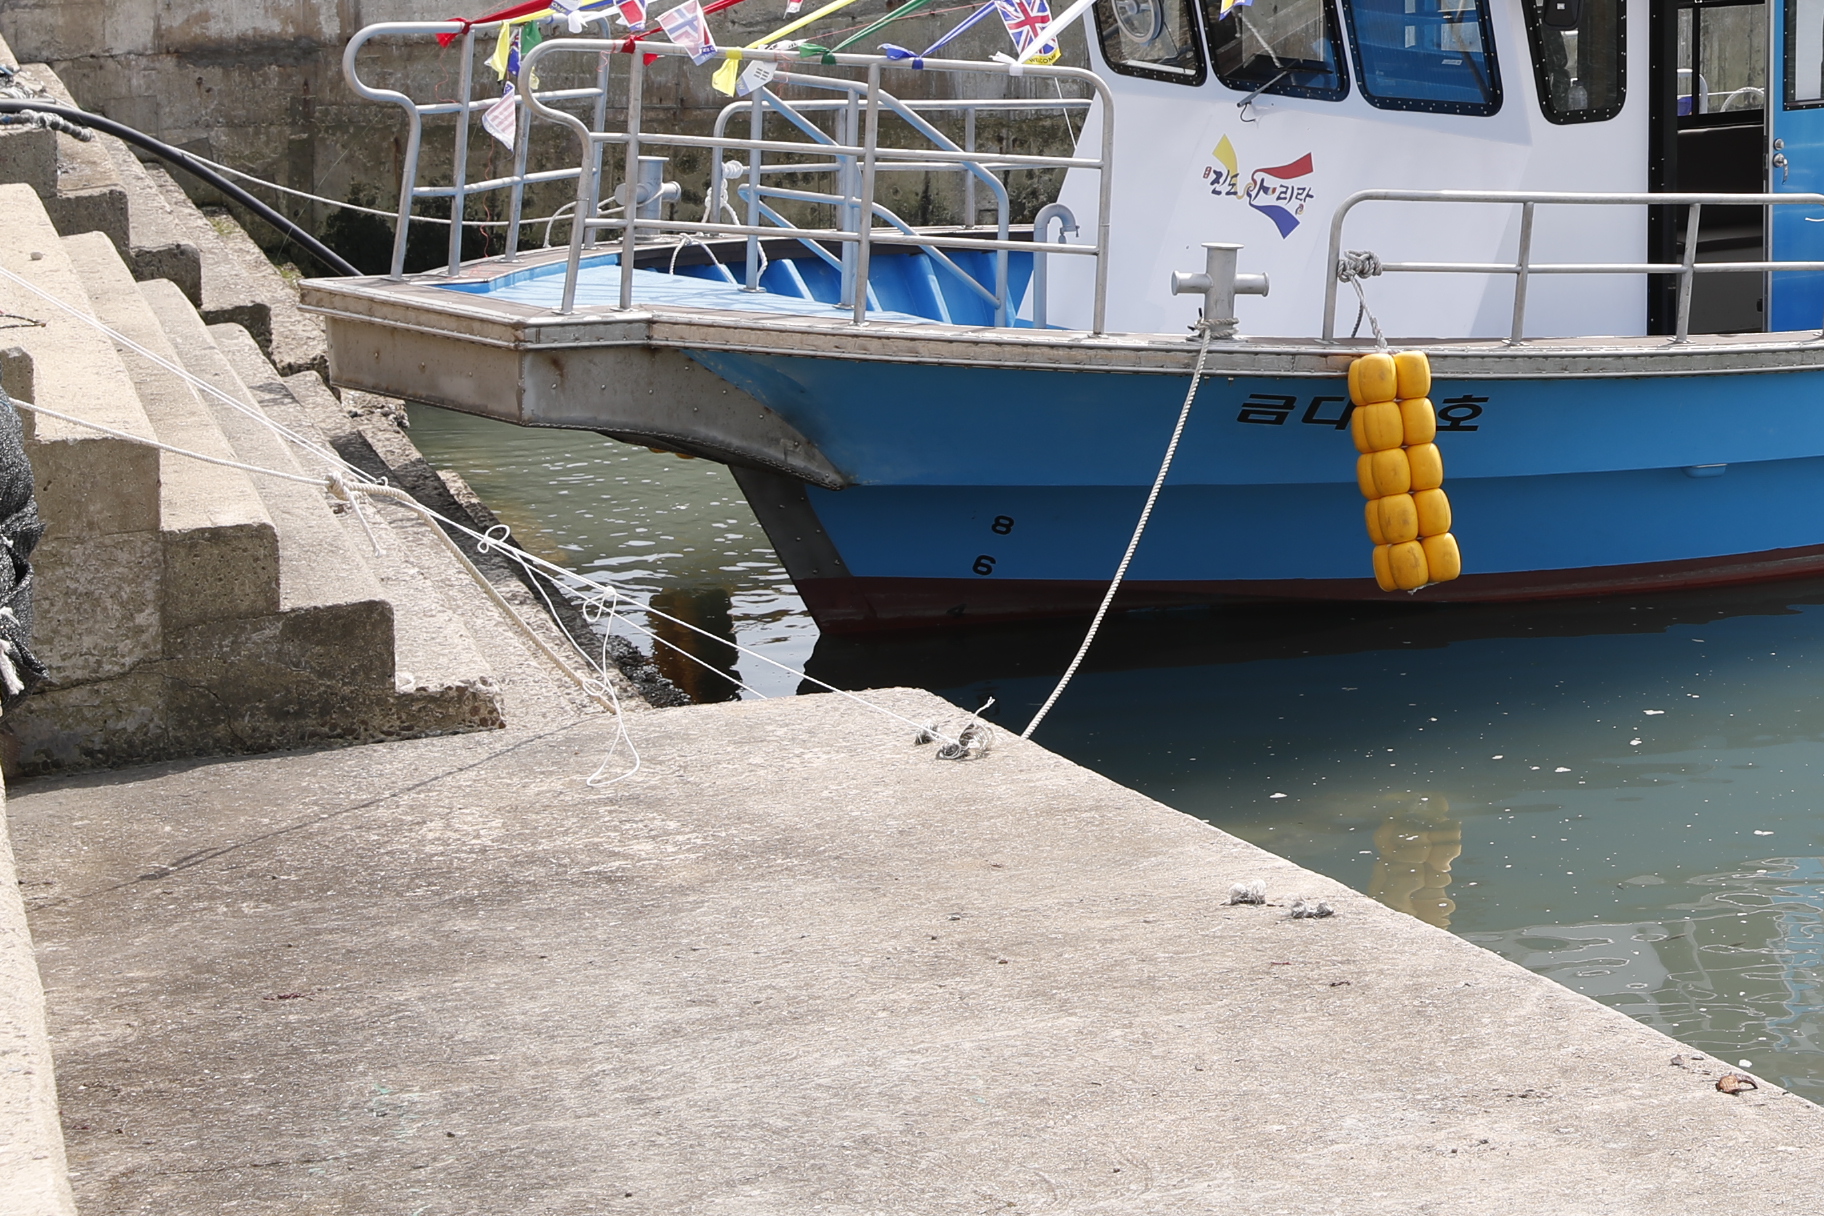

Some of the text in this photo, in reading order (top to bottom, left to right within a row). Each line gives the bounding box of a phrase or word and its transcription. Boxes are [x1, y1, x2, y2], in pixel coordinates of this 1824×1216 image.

[1209, 168, 1240, 196] 진도
[1237, 392, 1489, 432] 금다호
[991, 514, 1015, 535] 8
[972, 554, 997, 576] 6
